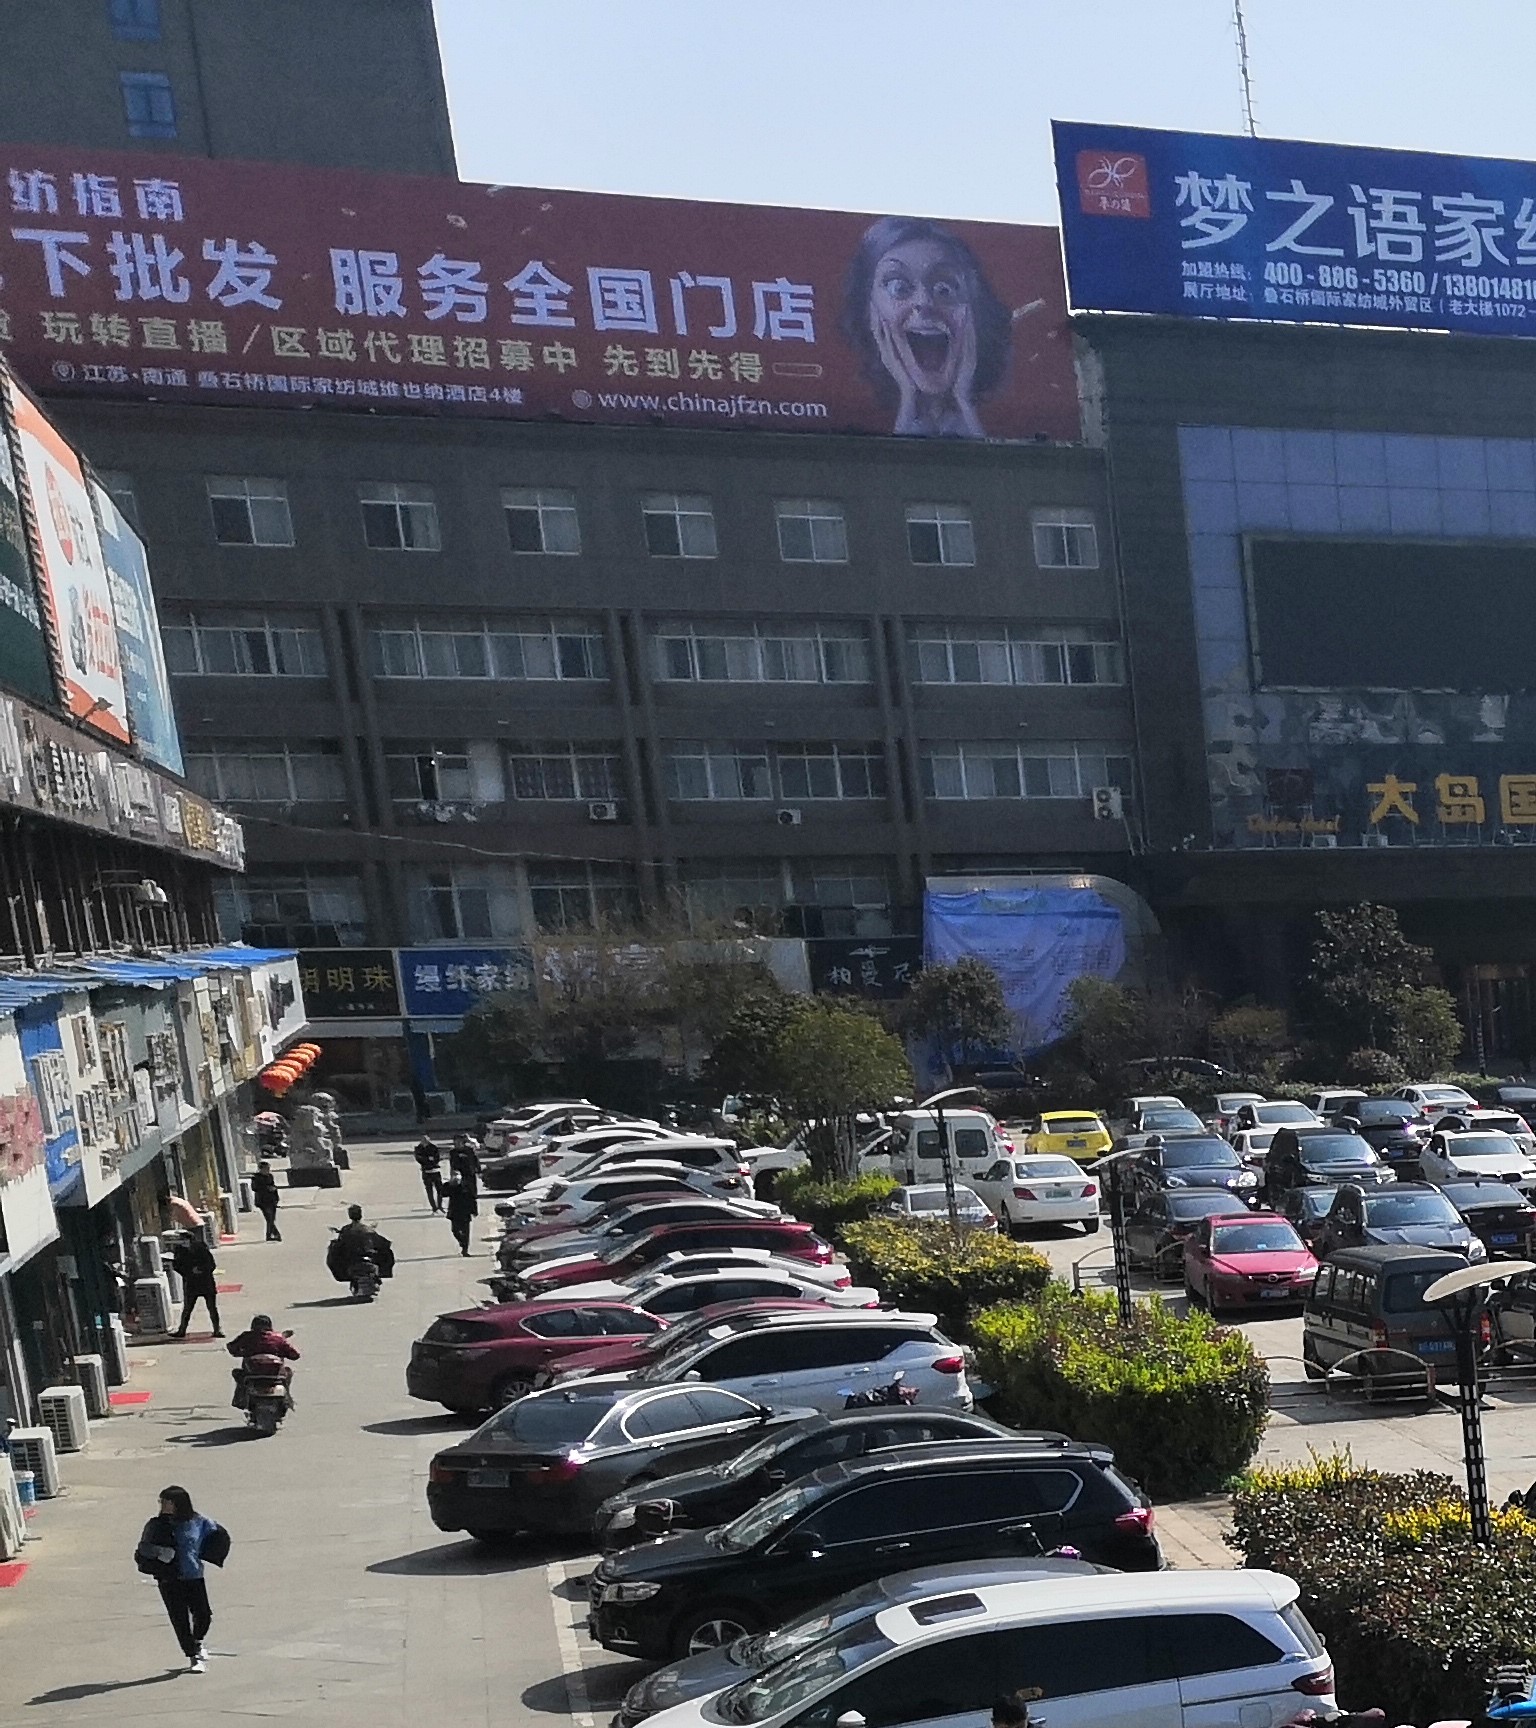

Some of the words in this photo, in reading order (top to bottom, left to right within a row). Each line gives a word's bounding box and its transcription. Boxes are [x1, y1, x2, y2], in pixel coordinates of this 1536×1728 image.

[329, 246, 816, 344] 服务全国门店
[603, 343, 765, 384] 先到先得
[597, 390, 828, 418] www.chinajfzn.com
